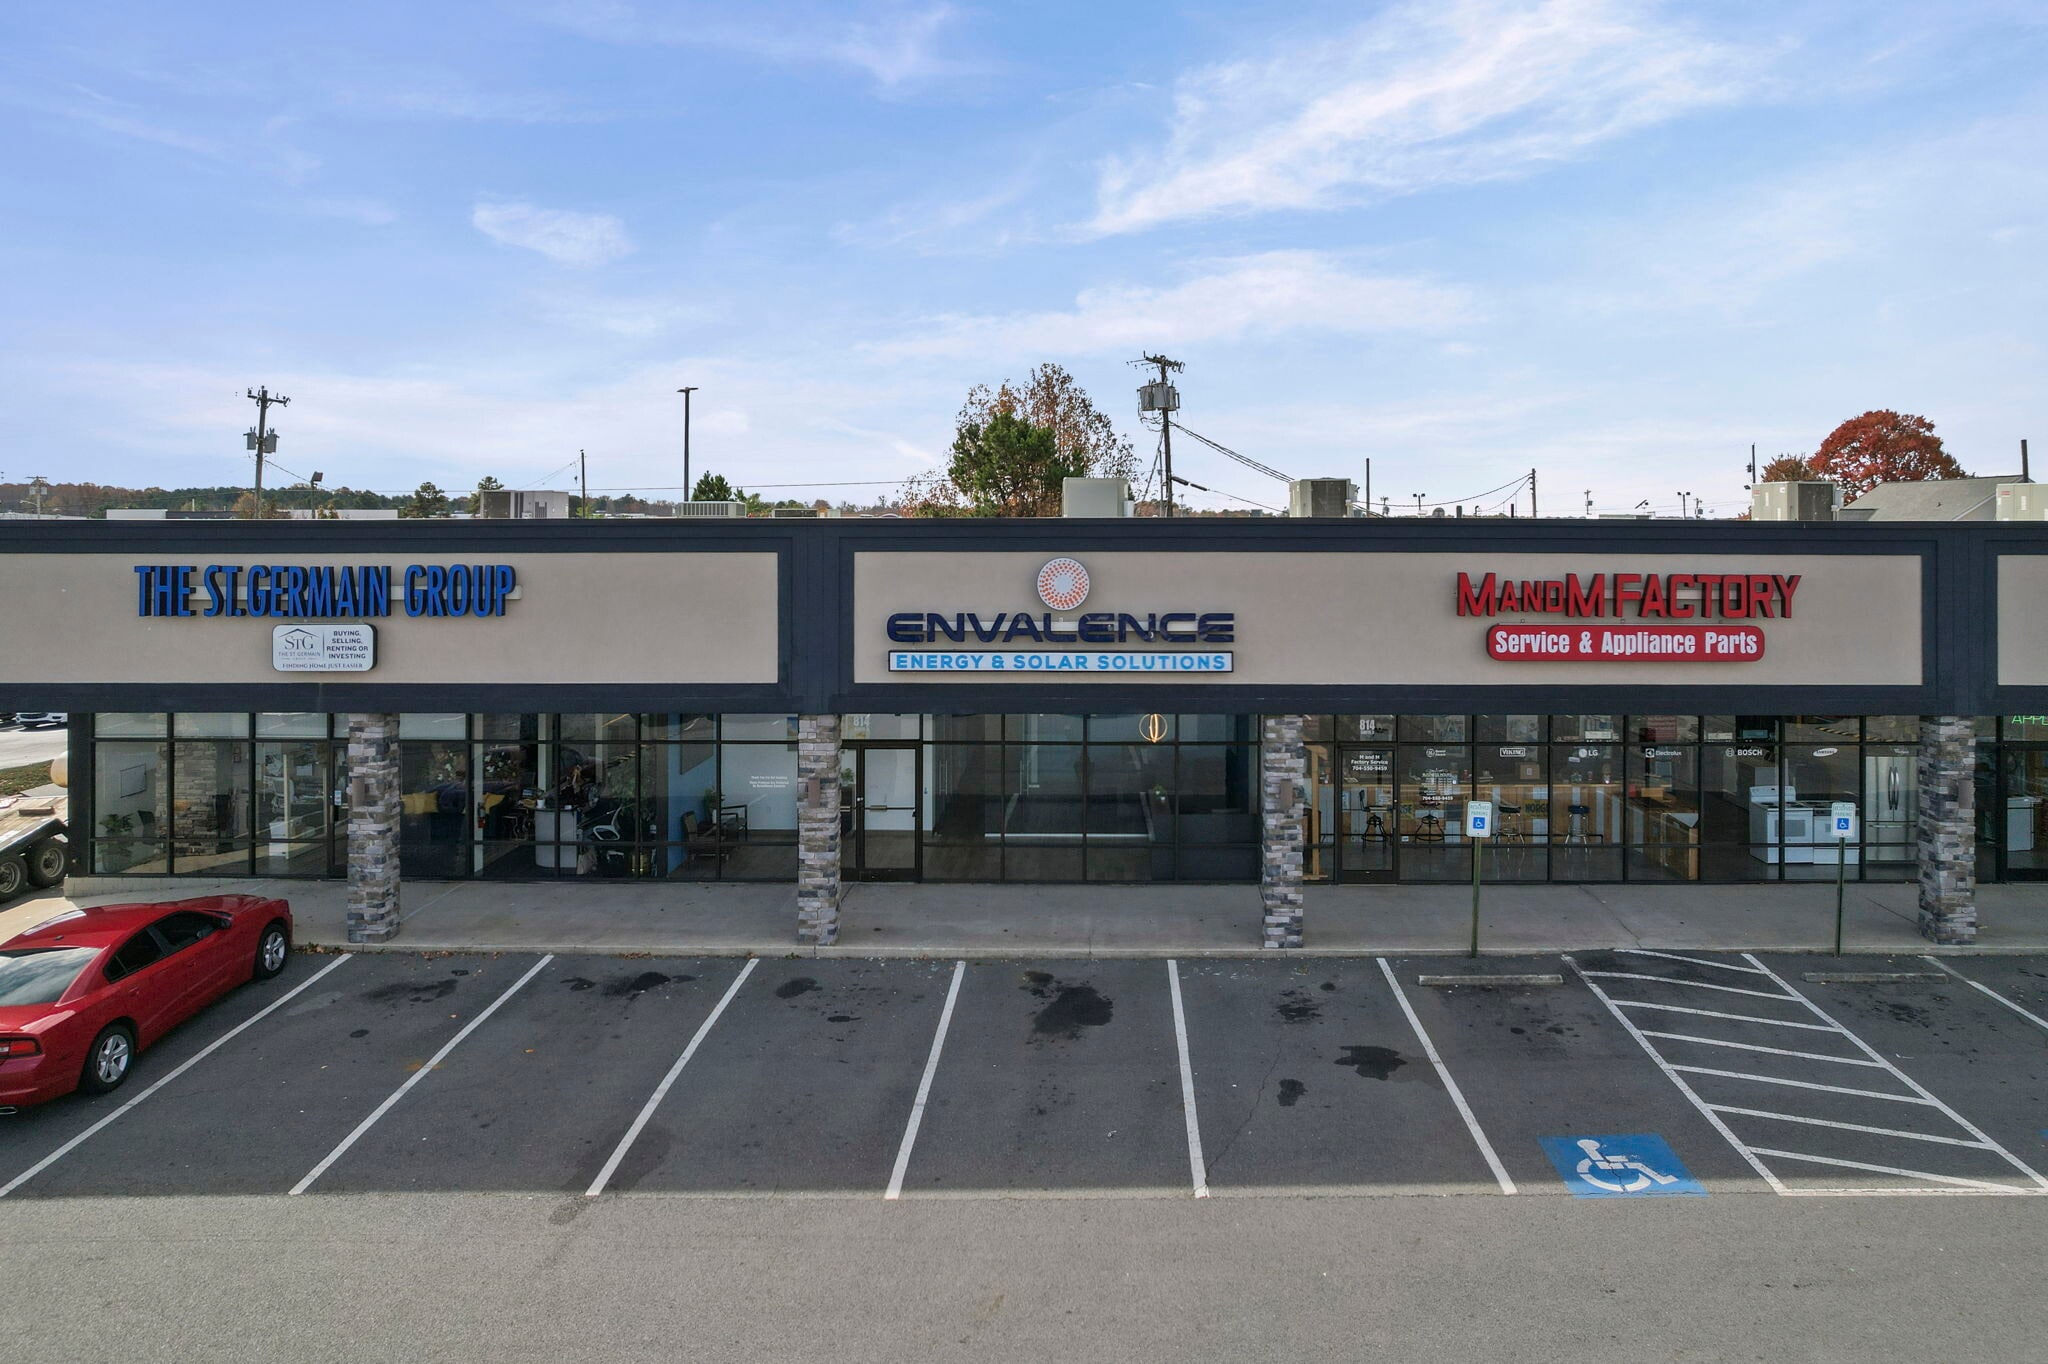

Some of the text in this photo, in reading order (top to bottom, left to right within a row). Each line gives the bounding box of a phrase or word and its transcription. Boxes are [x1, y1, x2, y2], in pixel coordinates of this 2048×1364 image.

[134, 565, 197, 617] THE
[403, 564, 516, 617] GROUP
[1613, 573, 1802, 618] FACTORY
[886, 612, 1235, 643] ENVALENCE
[1495, 631, 1758, 656] Service & Appliance Parts
[896, 655, 1226, 670] ENERGY & SOLAR SOLUTIONS
[1360, 719, 1376, 730] 814
[1525, 803, 1548, 812] NORG
